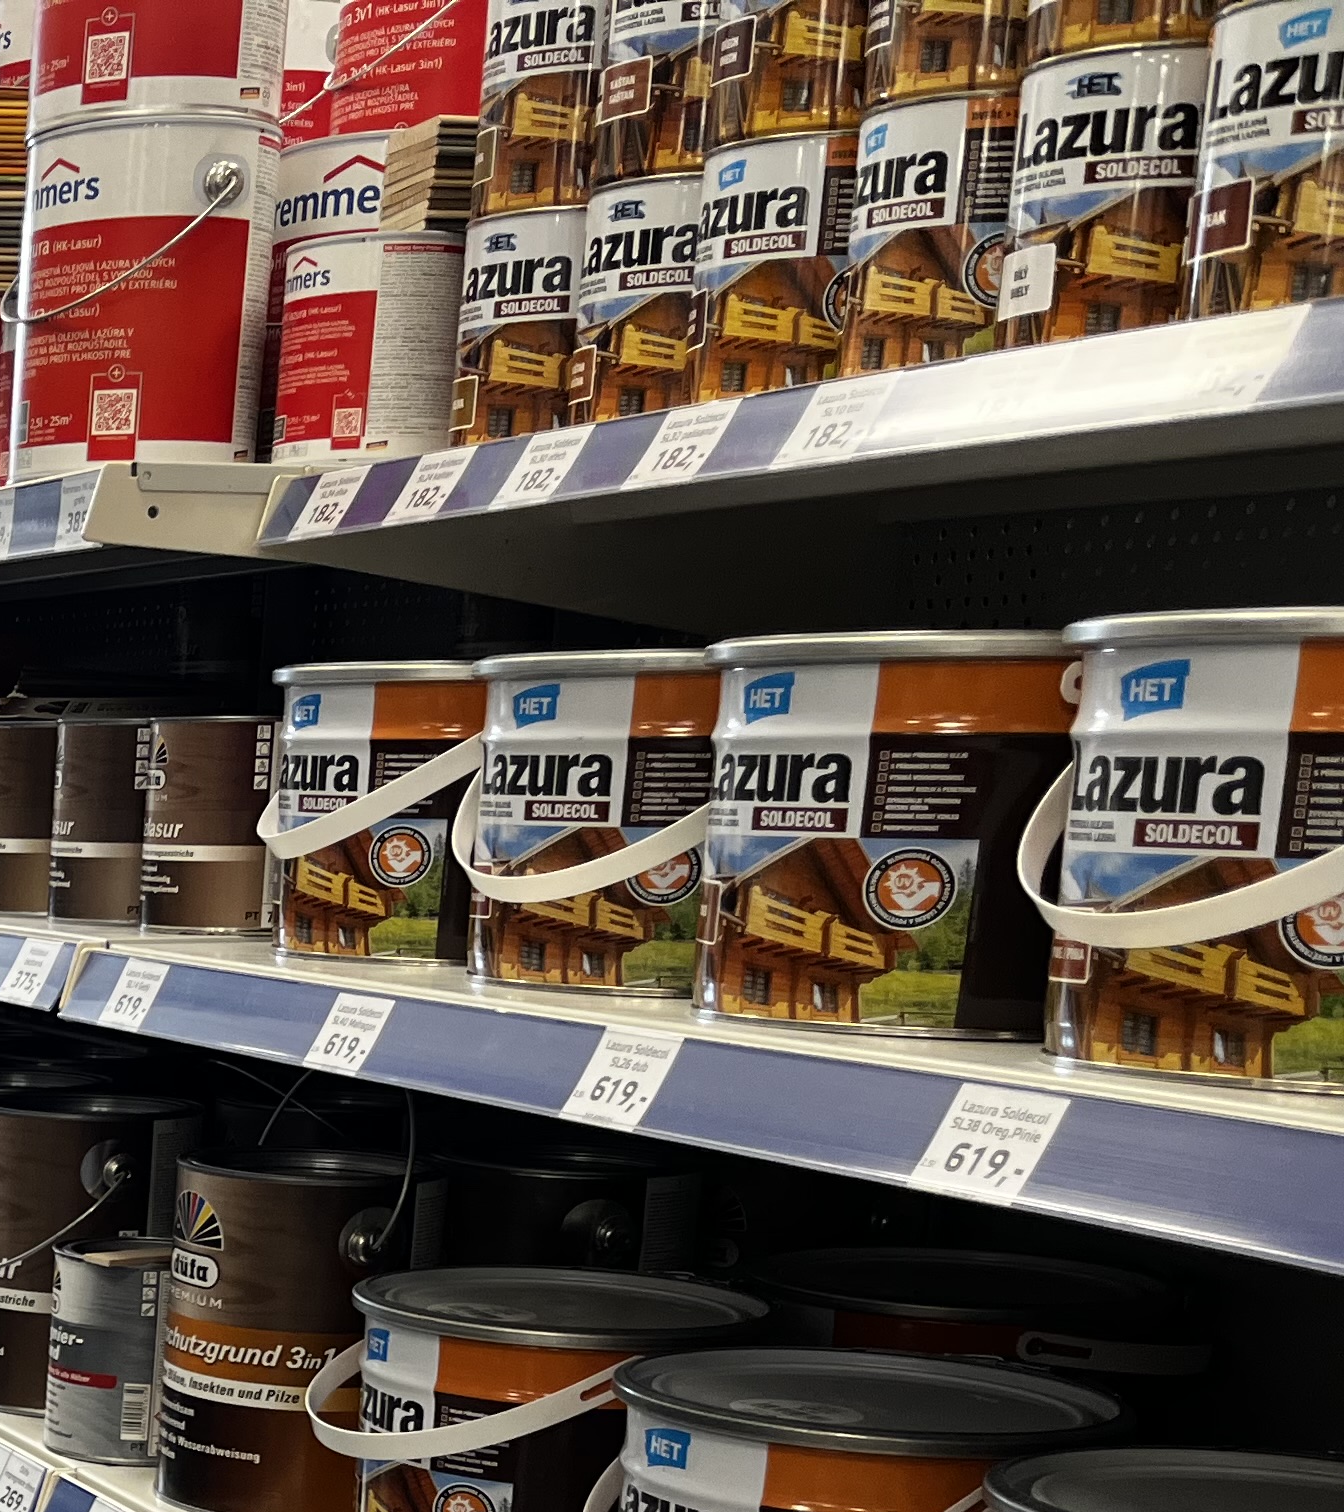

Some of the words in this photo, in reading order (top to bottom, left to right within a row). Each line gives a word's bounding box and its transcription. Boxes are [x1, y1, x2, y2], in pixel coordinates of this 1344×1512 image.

[1286, 19, 1323, 38] HET
[524, 47, 586, 69] SOLDECOL
[1076, 74, 1116, 96] HET
[1211, 47, 1344, 121] Lazu
[1018, 98, 1199, 173] Lazura
[722, 167, 742, 181] HET
[1095, 158, 1181, 179] SOLDECOL
[272, 182, 381, 228] remme
[872, 201, 935, 225] SOLDECOL
[52, 234, 102, 253] (HK-Lasur)
[626, 267, 692, 288] SOLDECOL
[654, 445, 706, 472] 182,-
[516, 467, 563, 493] 182,-
[307, 502, 344, 526] 182,-
[749, 688, 784, 708] HET
[1129, 679, 1176, 702] HET
[519, 696, 551, 716] HET
[532, 803, 599, 820] SOLDECOL
[760, 810, 835, 829] SOLDECOL
[1145, 823, 1242, 847] SOLDECOL
[15, 968, 42, 994] 375,-
[113, 994, 148, 1018] 619,-
[323, 1033, 366, 1064] 619,-
[589, 1076, 648, 1112] 619,-
[950, 1114, 981, 1132] SL38
[961, 1098, 999, 1118] Lazura
[1001, 1106, 1051, 1127] Soldecol
[944, 1142, 1025, 1188] 619,-
[189, 1376, 234, 1397] Insekten
[238, 1389, 261, 1400] und
[266, 1389, 300, 1404] Pilze
[649, 1438, 682, 1462] HET
